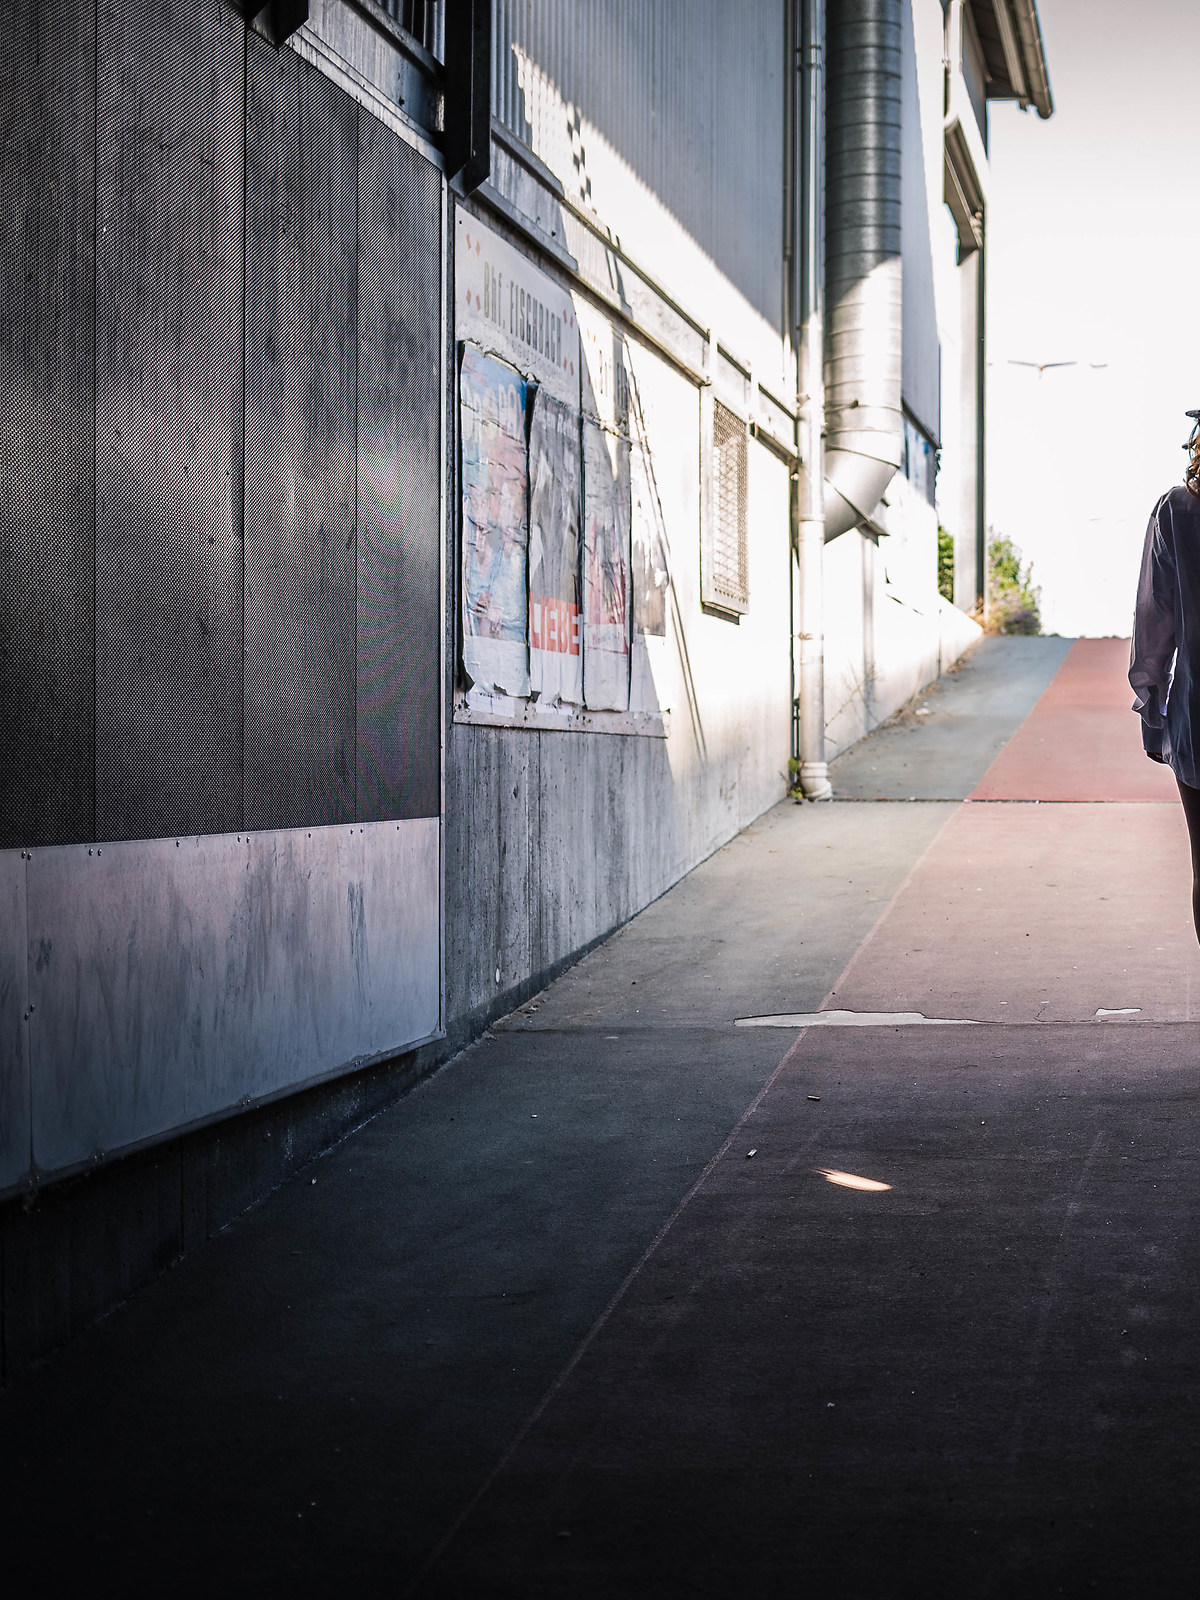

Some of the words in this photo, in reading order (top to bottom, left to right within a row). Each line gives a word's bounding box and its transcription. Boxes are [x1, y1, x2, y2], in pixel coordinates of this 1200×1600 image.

[483, 261, 506, 330] Bhf.
[510, 280, 562, 368] FISCHBACH
[529, 591, 579, 656] LIEBE
